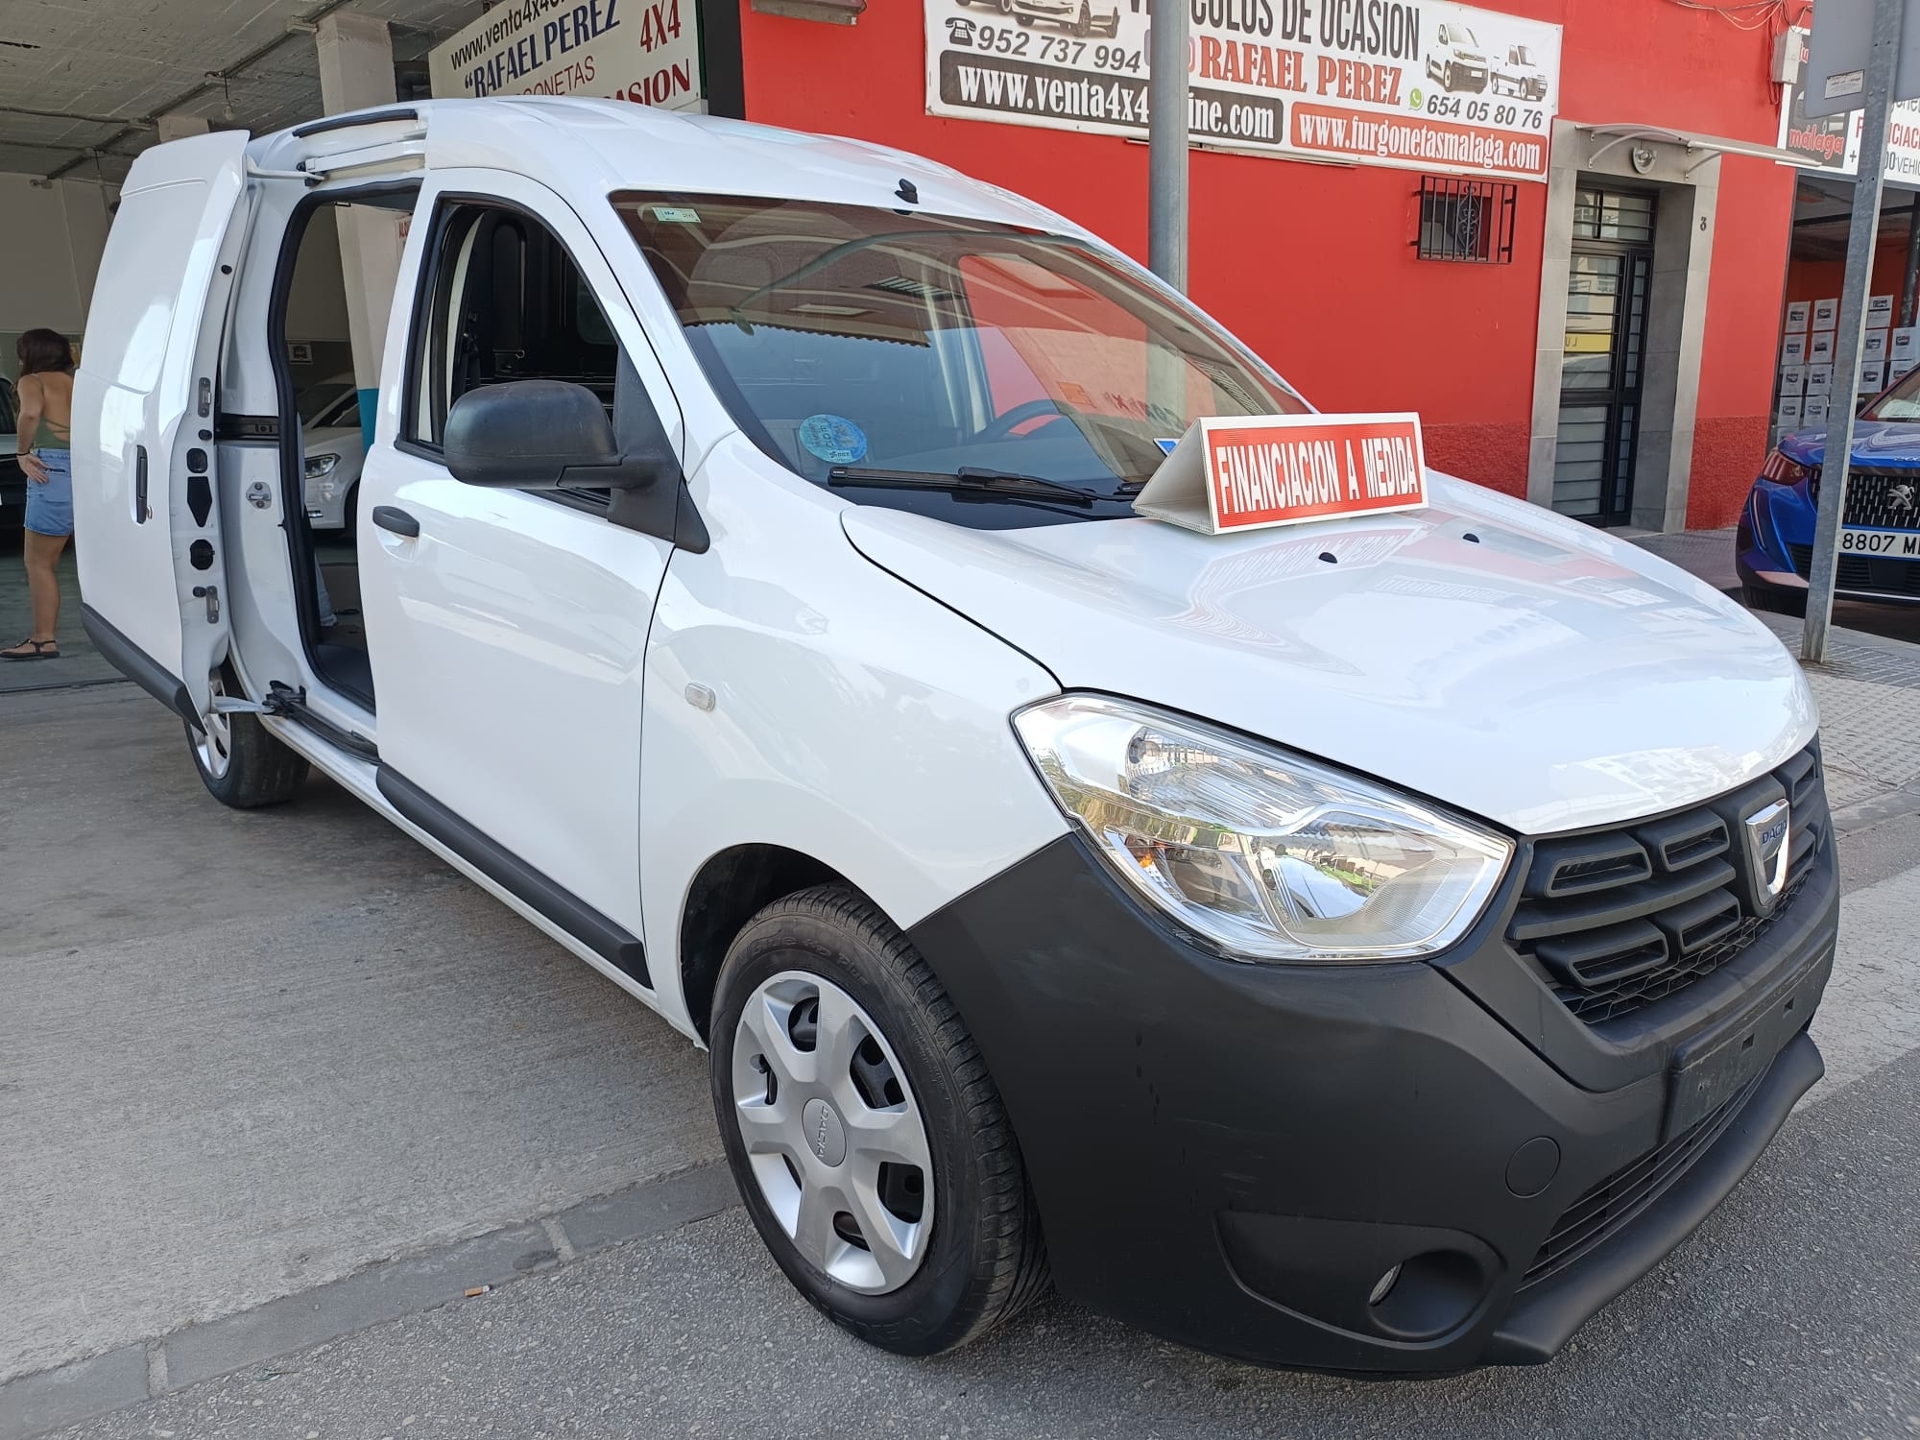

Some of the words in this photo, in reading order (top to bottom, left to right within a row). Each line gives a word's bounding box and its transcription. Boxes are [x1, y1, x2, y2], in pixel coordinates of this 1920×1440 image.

[544, 0, 620, 62] PEREZ
[639, 0, 682, 53] 4X4
[978, 25, 1030, 57] 952
[1040, 35, 1086, 66] 737
[1093, 44, 1142, 74] 994
[1281, 0, 1311, 44] DE
[1320, 0, 1420, 62] OCASION
[1199, 35, 1308, 93] RAFAEL
[1317, 55, 1402, 106] PEREZ
[1427, 94, 1461, 118] 654
[1467, 101, 1490, 121] 05
[1494, 105, 1517, 126] 80
[1522, 109, 1543, 130] 76
[1299, 113, 1541, 170] www.furgonetasmalaga.com
[1215, 440, 1341, 515] FINANCIACION
[1346, 439, 1361, 501] A
[1361, 436, 1419, 499] MEDIDA
[1842, 532, 1896, 553] 8807
[817, 1106, 829, 1158] DACIA
